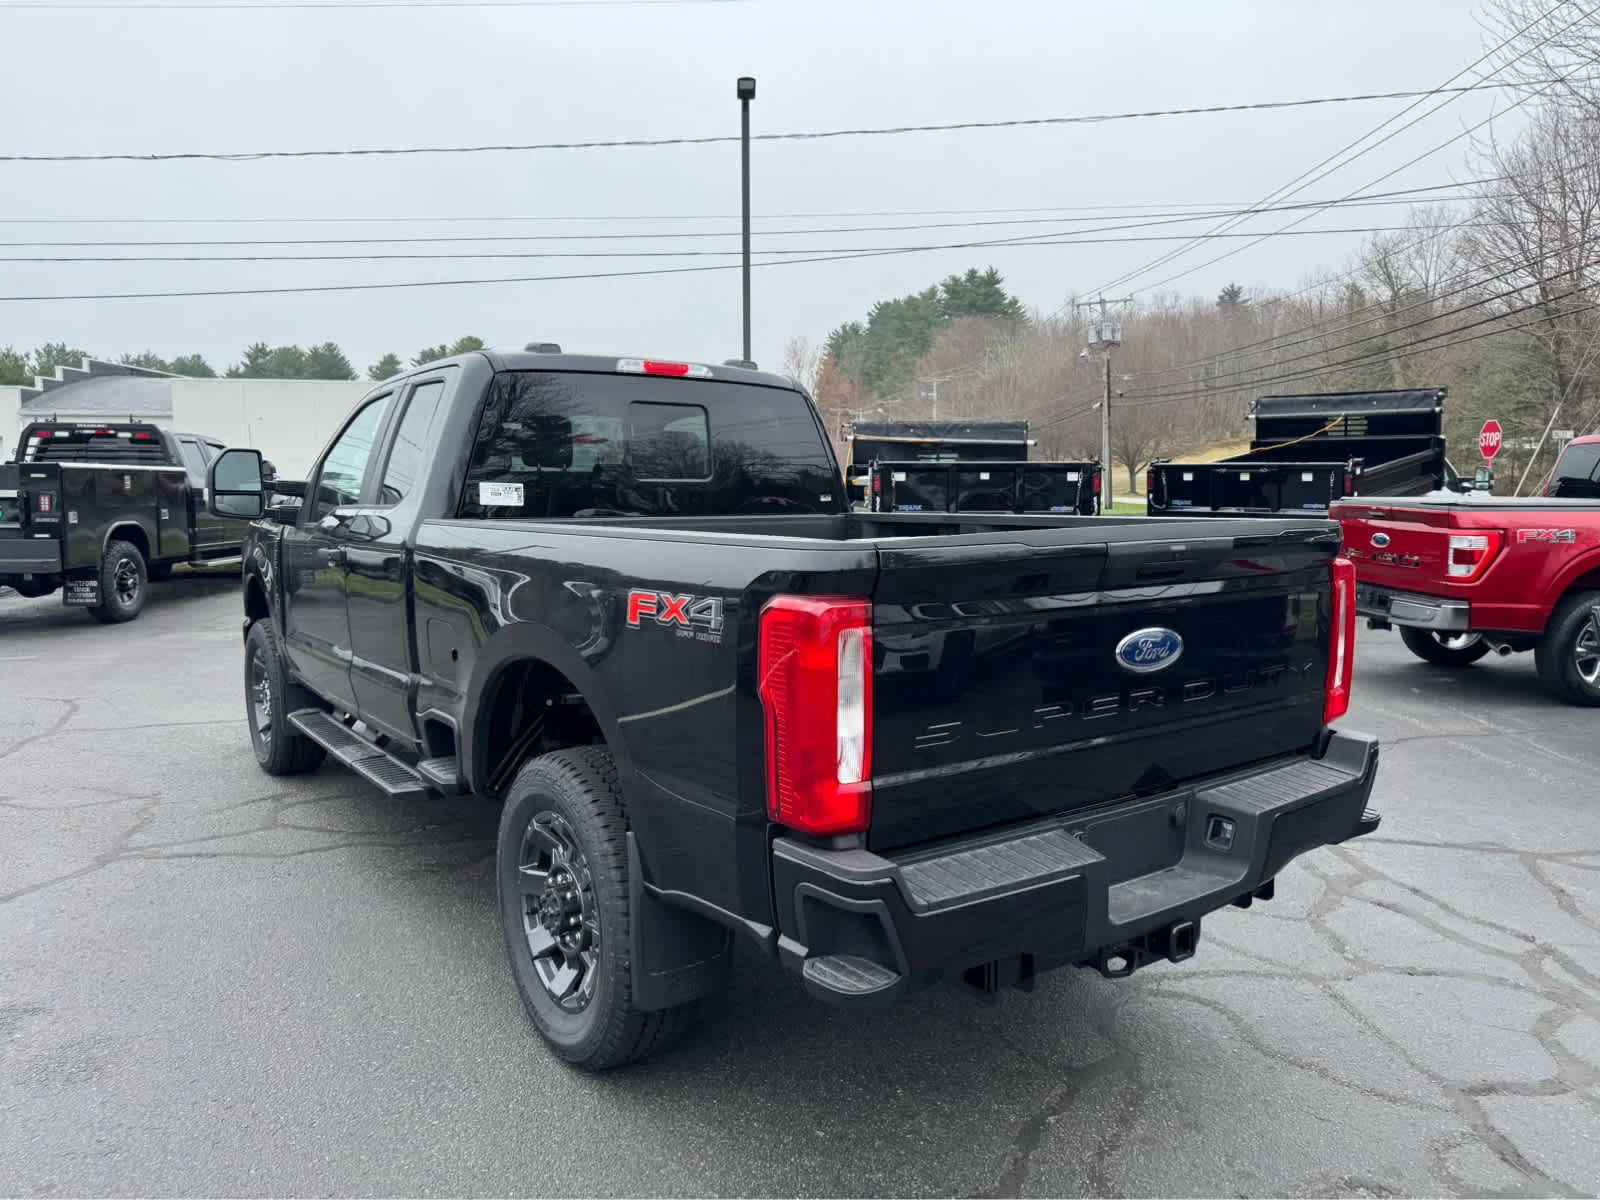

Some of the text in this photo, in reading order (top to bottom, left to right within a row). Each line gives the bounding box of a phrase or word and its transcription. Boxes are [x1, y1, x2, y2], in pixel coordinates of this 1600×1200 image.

[1480, 432, 1500, 446] STOP
[1517, 528, 1576, 544] FX4
[625, 587, 724, 635] FX4
[1135, 639, 1170, 661] Ford
[1183, 659, 1313, 703] DUTY
